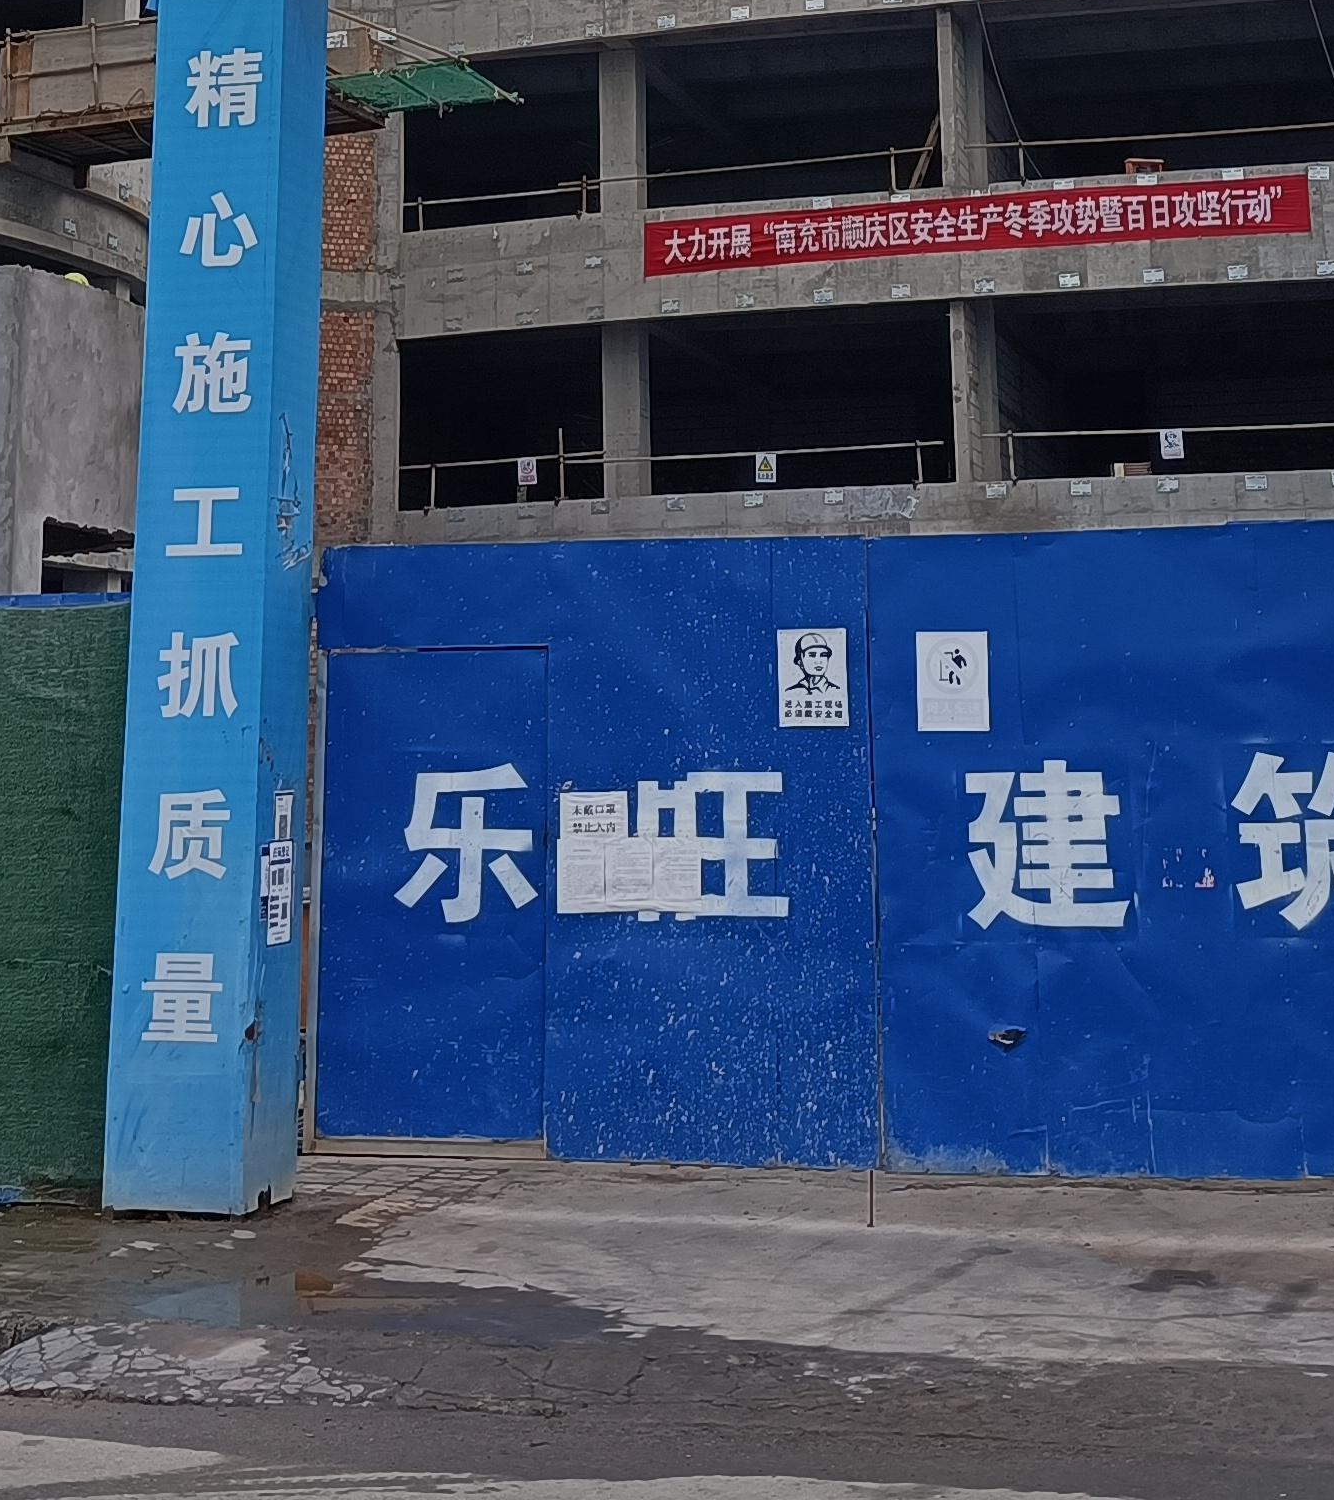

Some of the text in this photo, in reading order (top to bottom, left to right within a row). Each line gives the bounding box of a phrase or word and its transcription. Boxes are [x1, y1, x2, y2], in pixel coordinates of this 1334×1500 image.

[141, 47, 263, 1044] 精心施工抓质量
